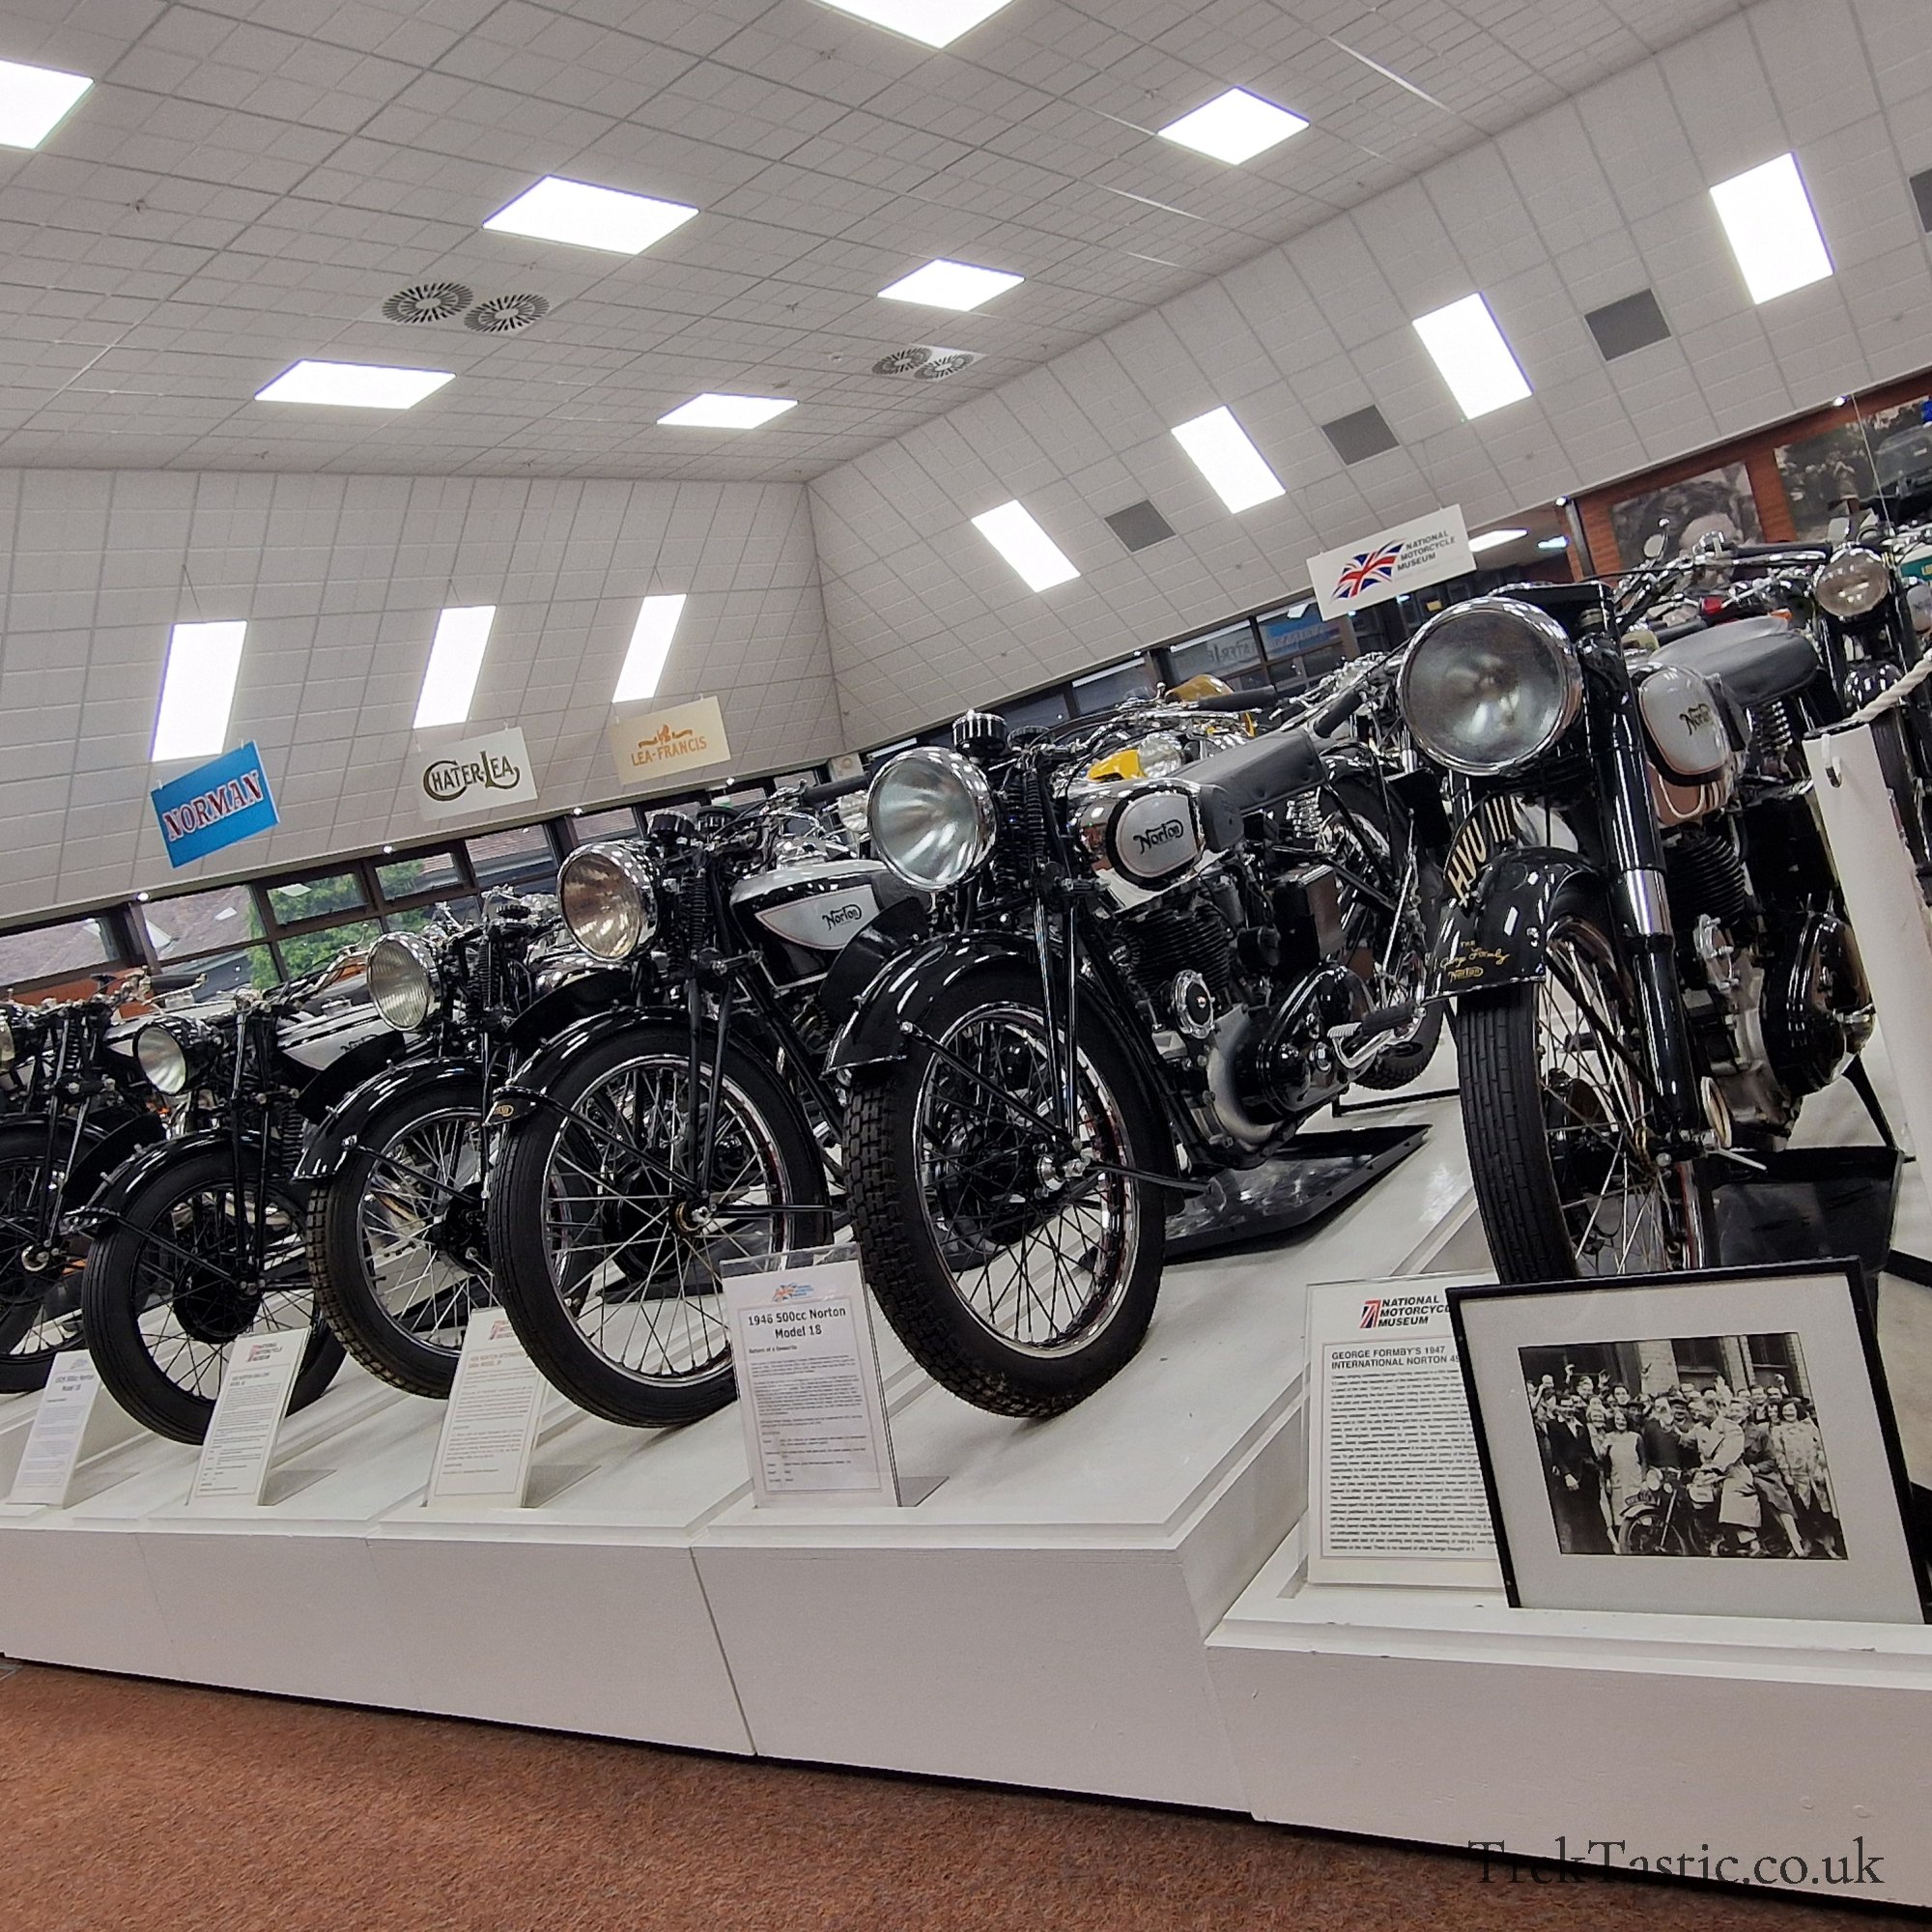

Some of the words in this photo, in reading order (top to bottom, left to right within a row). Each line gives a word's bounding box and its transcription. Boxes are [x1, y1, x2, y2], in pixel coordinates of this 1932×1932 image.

[1401, 536, 1456, 561] MOTORCYCLE
[1406, 530, 1449, 551] NATIONAL
[1397, 553, 1436, 572] MUSEUM
[631, 736, 708, 767] LEA-FRANCIS
[162, 770, 264, 842] NORMAN
[1132, 819, 1184, 855] Norton
[822, 903, 863, 931] Norton
[1382, 1295, 1439, 1308] NATIONAL
[776, 1311, 808, 1323] 500cc
[809, 1307, 846, 1320] Norton
[1378, 1316, 1430, 1327] MUSEUM
[775, 1325, 807, 1339] Model
[809, 1324, 823, 1335] 18
[1331, 1350, 1371, 1360] GEORGE
[1373, 1347, 1422, 1357] FORMBY'S
[1425, 1346, 1446, 1354] 1947
[1331, 1358, 1405, 1370] INTERNATIONAL
[1406, 1355, 1448, 1367] NORTON
